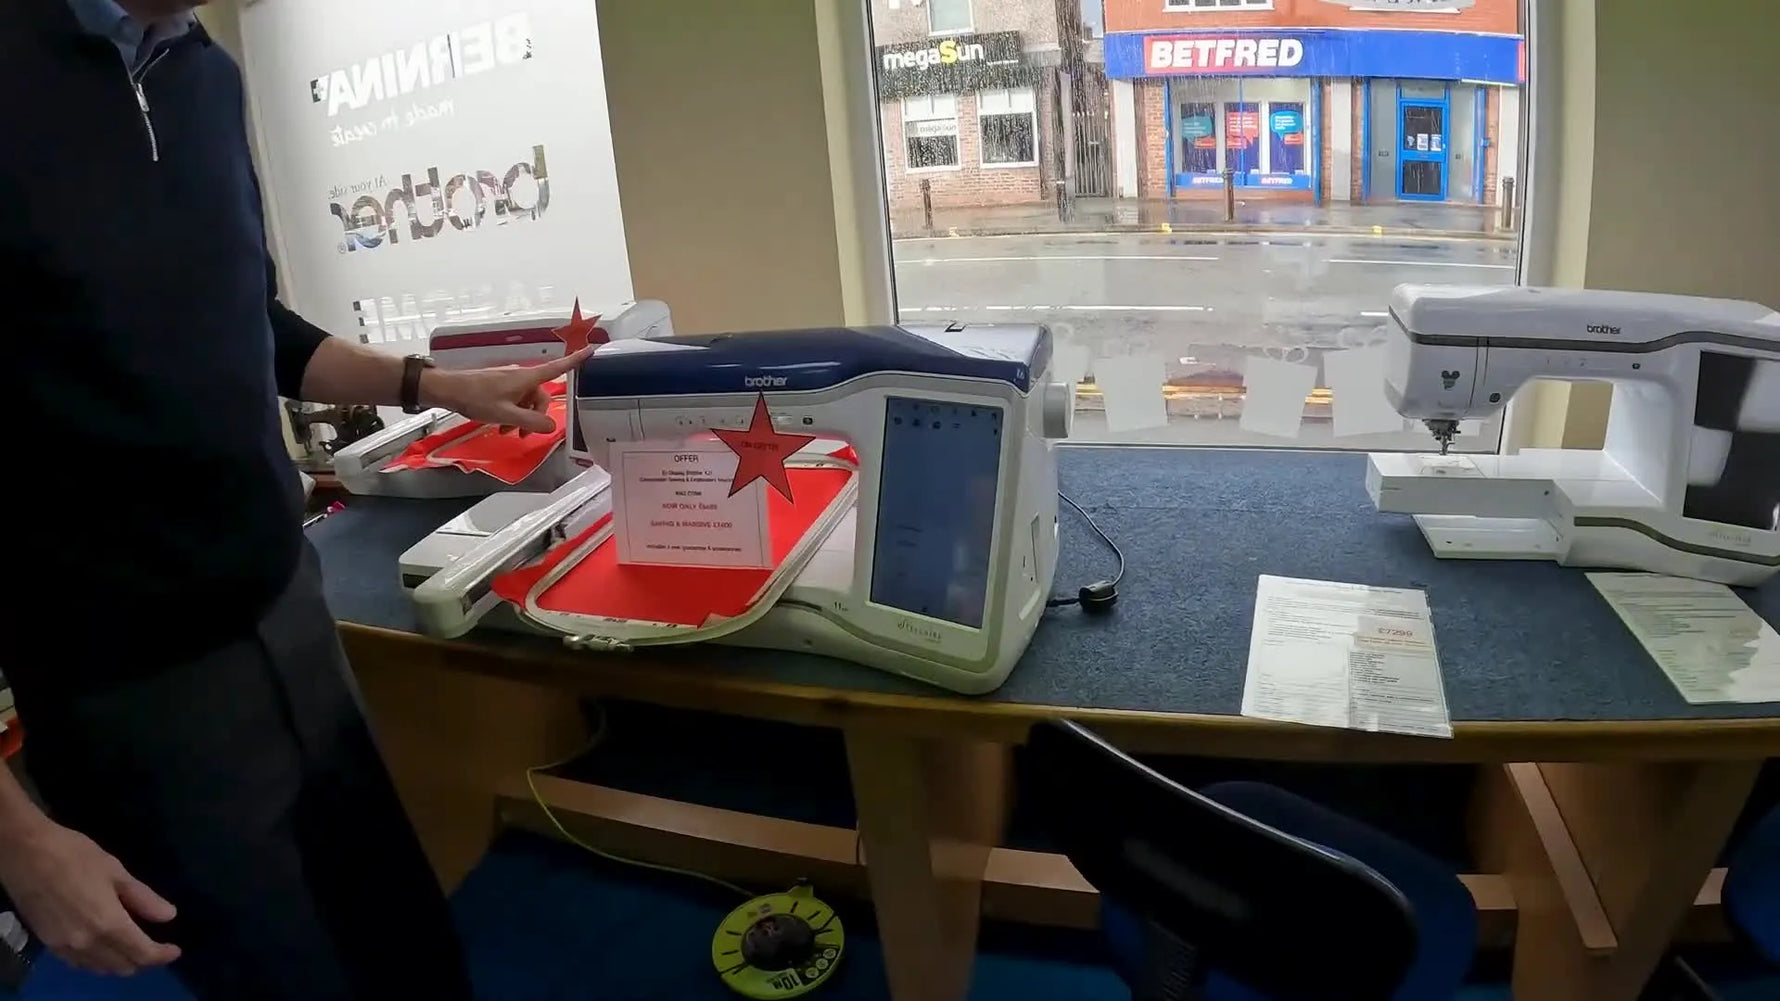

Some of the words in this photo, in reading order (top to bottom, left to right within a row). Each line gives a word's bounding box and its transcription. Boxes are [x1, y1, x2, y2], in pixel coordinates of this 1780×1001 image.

[883, 40, 985, 71] megaSun
[1150, 38, 1304, 68] BETFRED
[1586, 324, 1622, 335] brother
[744, 375, 788, 388] brother
[673, 454, 699, 464] OFFER
